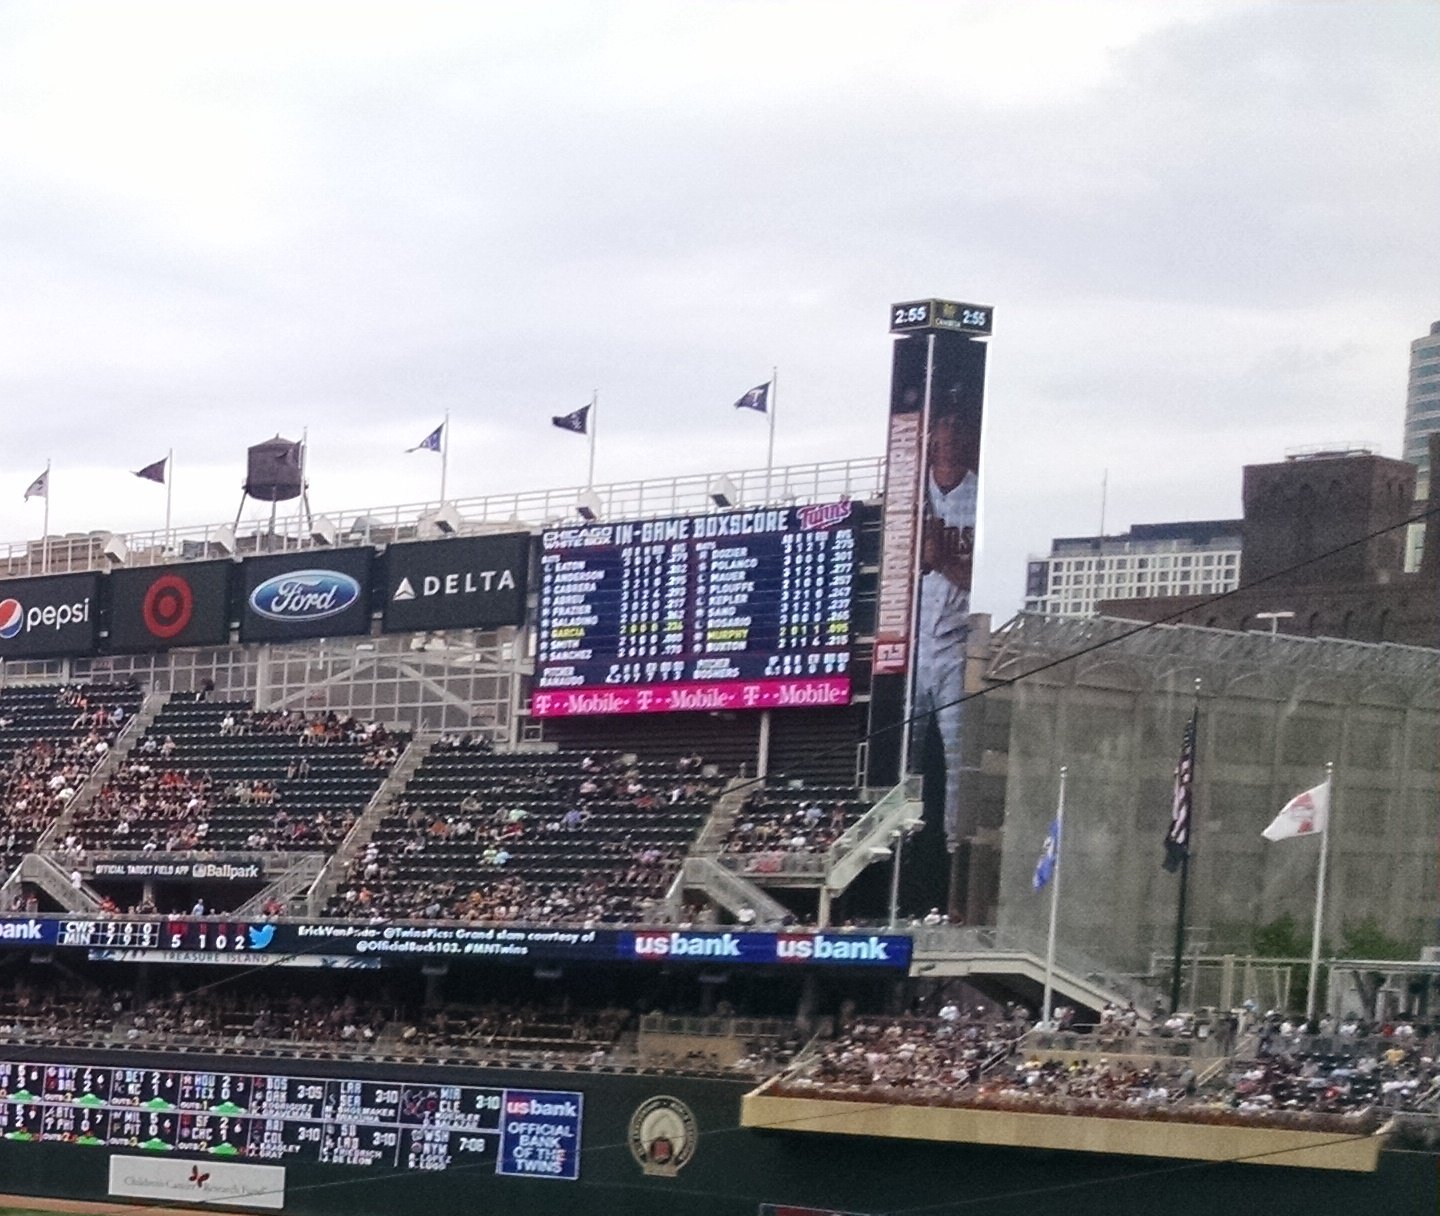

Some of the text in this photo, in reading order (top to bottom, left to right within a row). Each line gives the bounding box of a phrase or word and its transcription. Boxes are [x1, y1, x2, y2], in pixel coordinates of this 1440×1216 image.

[895, 306, 927, 324] 2:55
[616, 510, 789, 545] IN-GAME BOXSCORE
[423, 570, 516, 596] DELTA
[271, 578, 339, 615] Ford
[26, 598, 90, 633] pepsi
[207, 864, 259, 880] Ballpark
[508, 1122, 574, 1138] OFFICIAL
[519, 1135, 561, 1147] BANK
[513, 1147, 566, 1161] OF THE
[516, 1160, 563, 1174] TWINS
